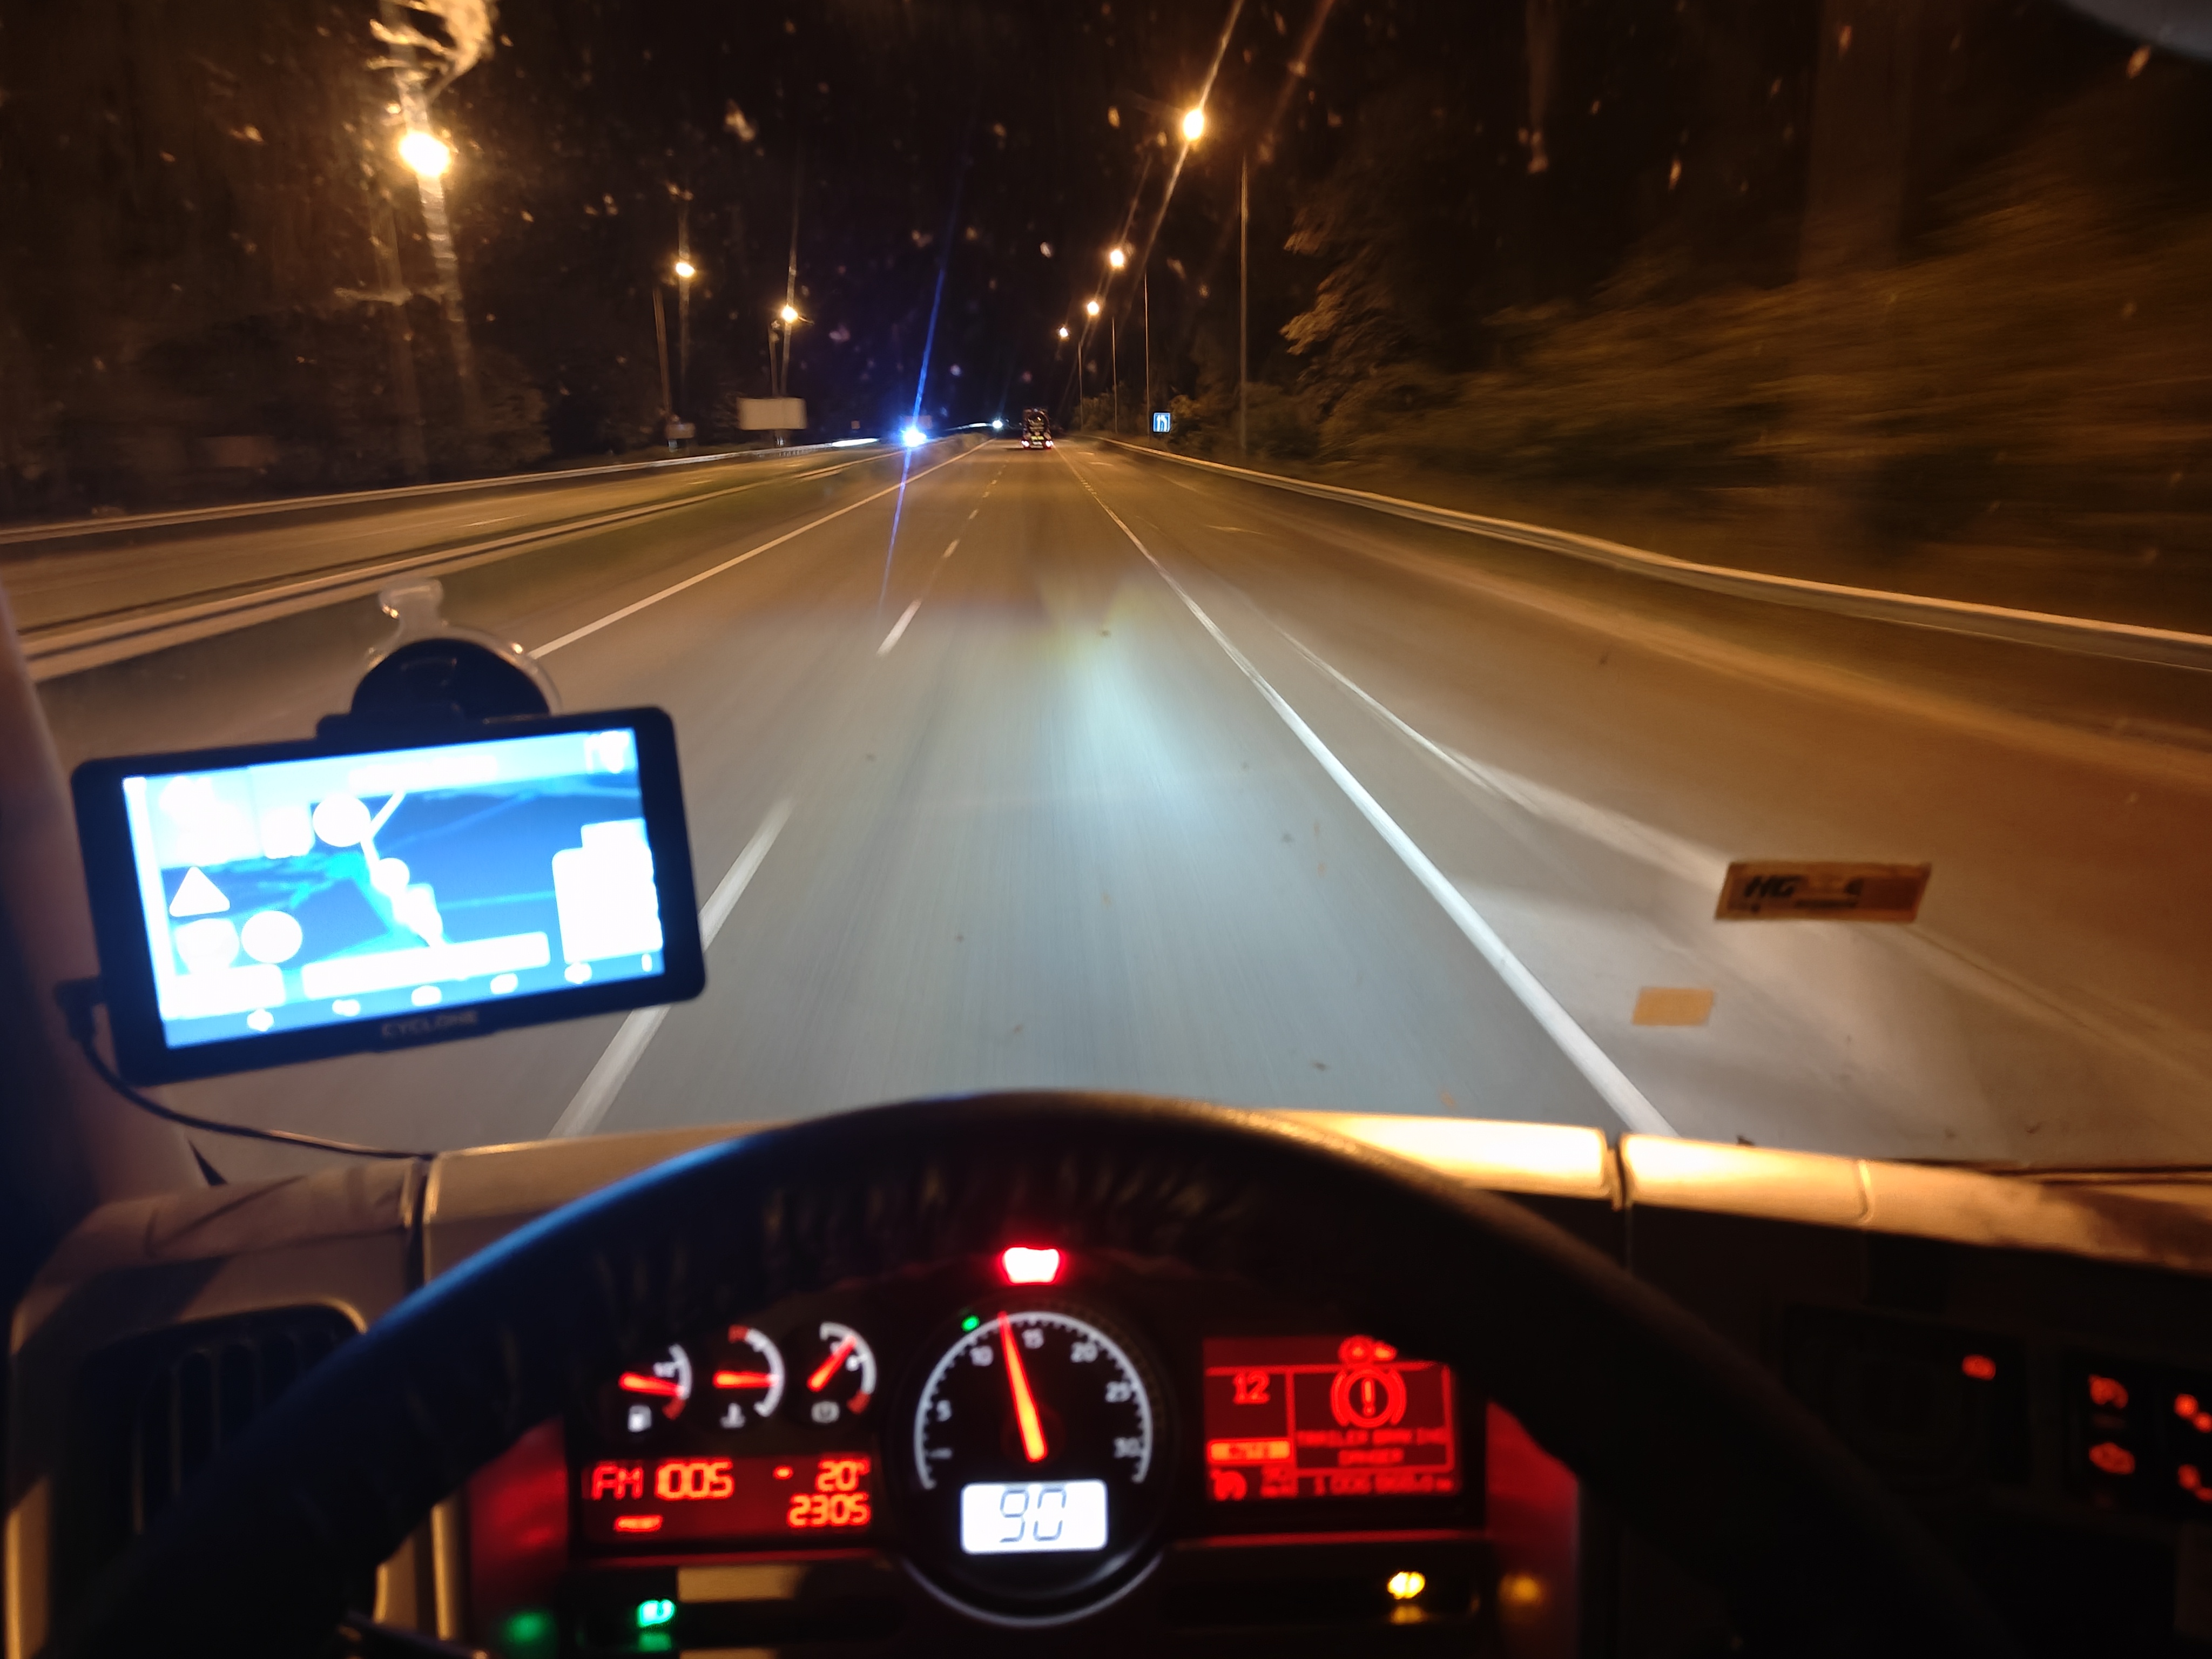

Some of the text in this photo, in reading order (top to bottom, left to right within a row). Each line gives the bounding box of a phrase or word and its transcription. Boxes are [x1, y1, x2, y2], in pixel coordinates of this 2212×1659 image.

[1233, 1371, 1270, 1405] 12
[592, 1463, 644, 1500] FM
[999, 1487, 1067, 1543] 90
